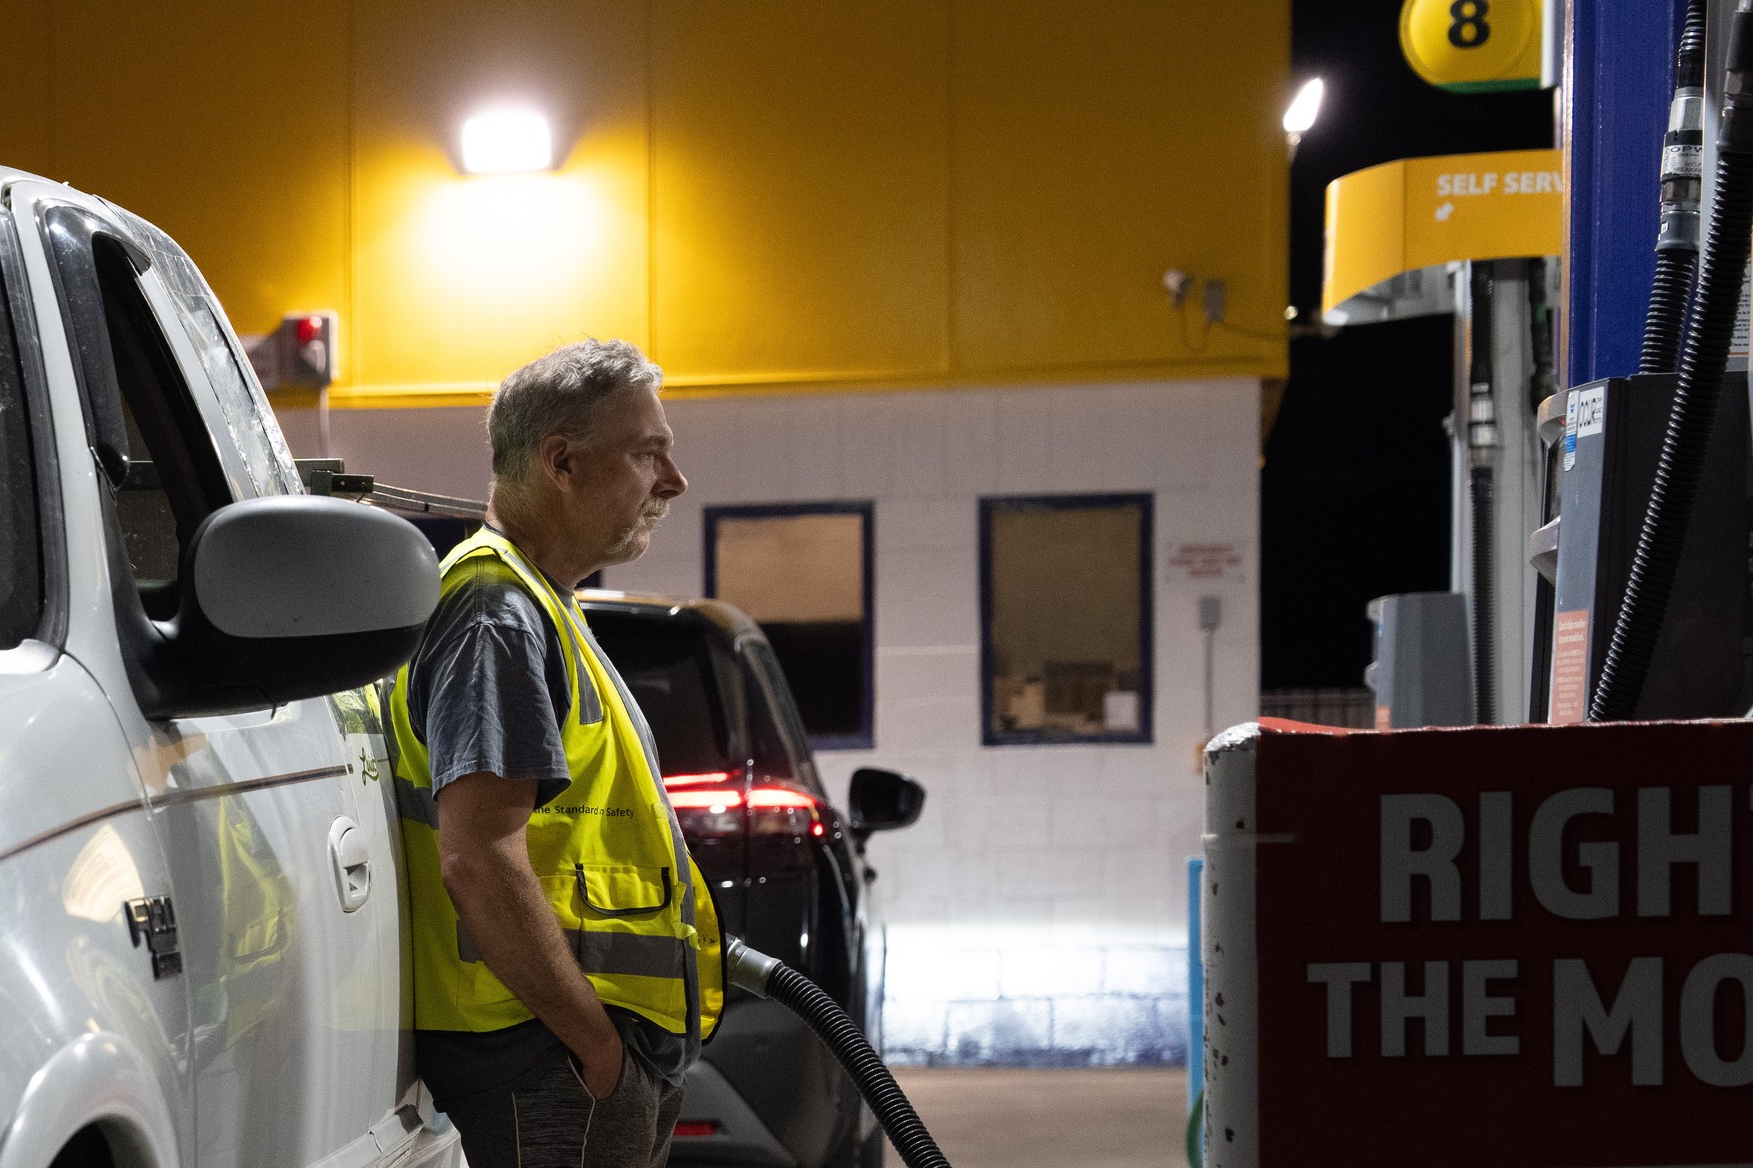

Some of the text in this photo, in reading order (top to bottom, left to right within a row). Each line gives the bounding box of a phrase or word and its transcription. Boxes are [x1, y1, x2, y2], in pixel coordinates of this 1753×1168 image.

[1448, 0, 1490, 48] 8
[1437, 173, 1498, 197] SELF
[606, 807, 635, 819] Safety
[1380, 784, 1753, 923] RIGH
[1307, 958, 1520, 1059] THE
